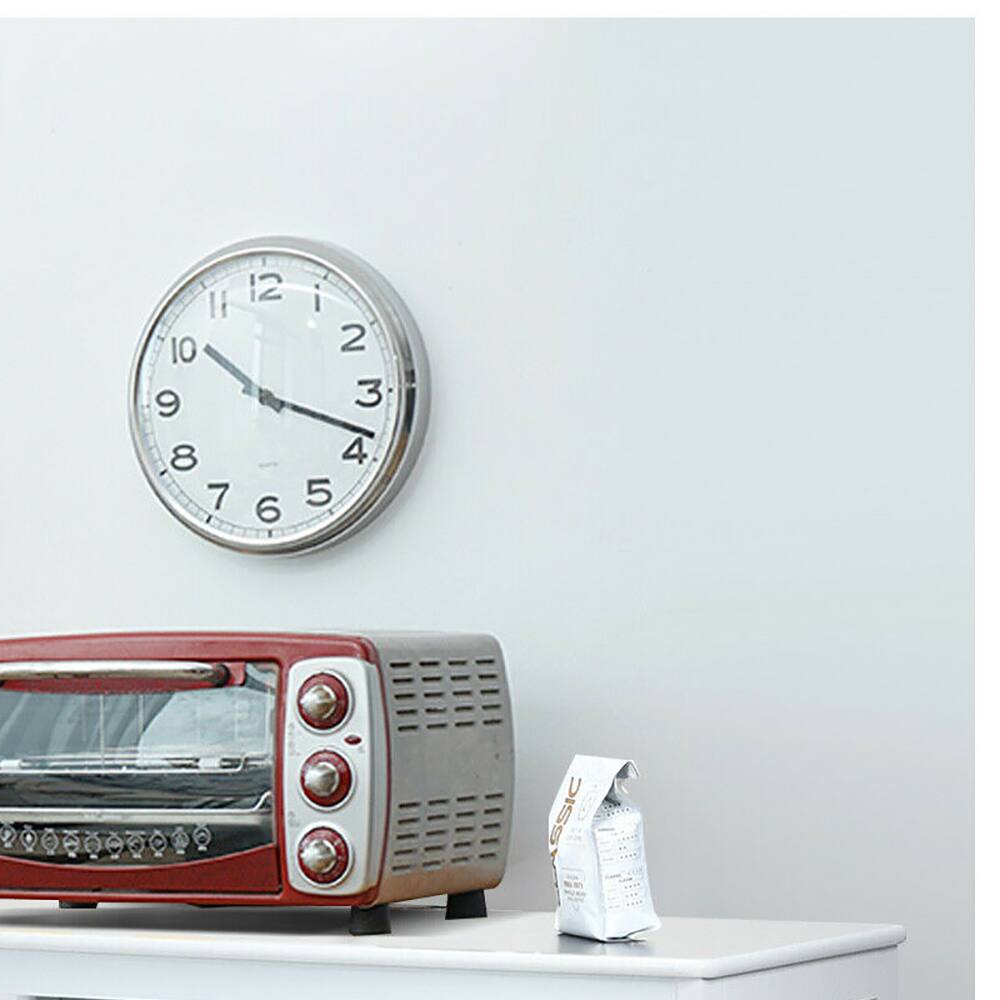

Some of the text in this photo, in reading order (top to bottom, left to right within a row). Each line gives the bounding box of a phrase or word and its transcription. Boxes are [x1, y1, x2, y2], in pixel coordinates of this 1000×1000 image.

[250, 273, 282, 302] 12
[313, 283, 321, 312] 1
[208, 290, 227, 319] 11
[171, 336, 198, 364] 10
[340, 324, 366, 352] 2
[155, 390, 180, 417] 9
[355, 379, 382, 408] 3
[170, 444, 198, 471] 8
[342, 436, 368, 465] 4
[207, 482, 230, 510] 7
[306, 478, 332, 507] 5
[256, 495, 281, 524] 6
